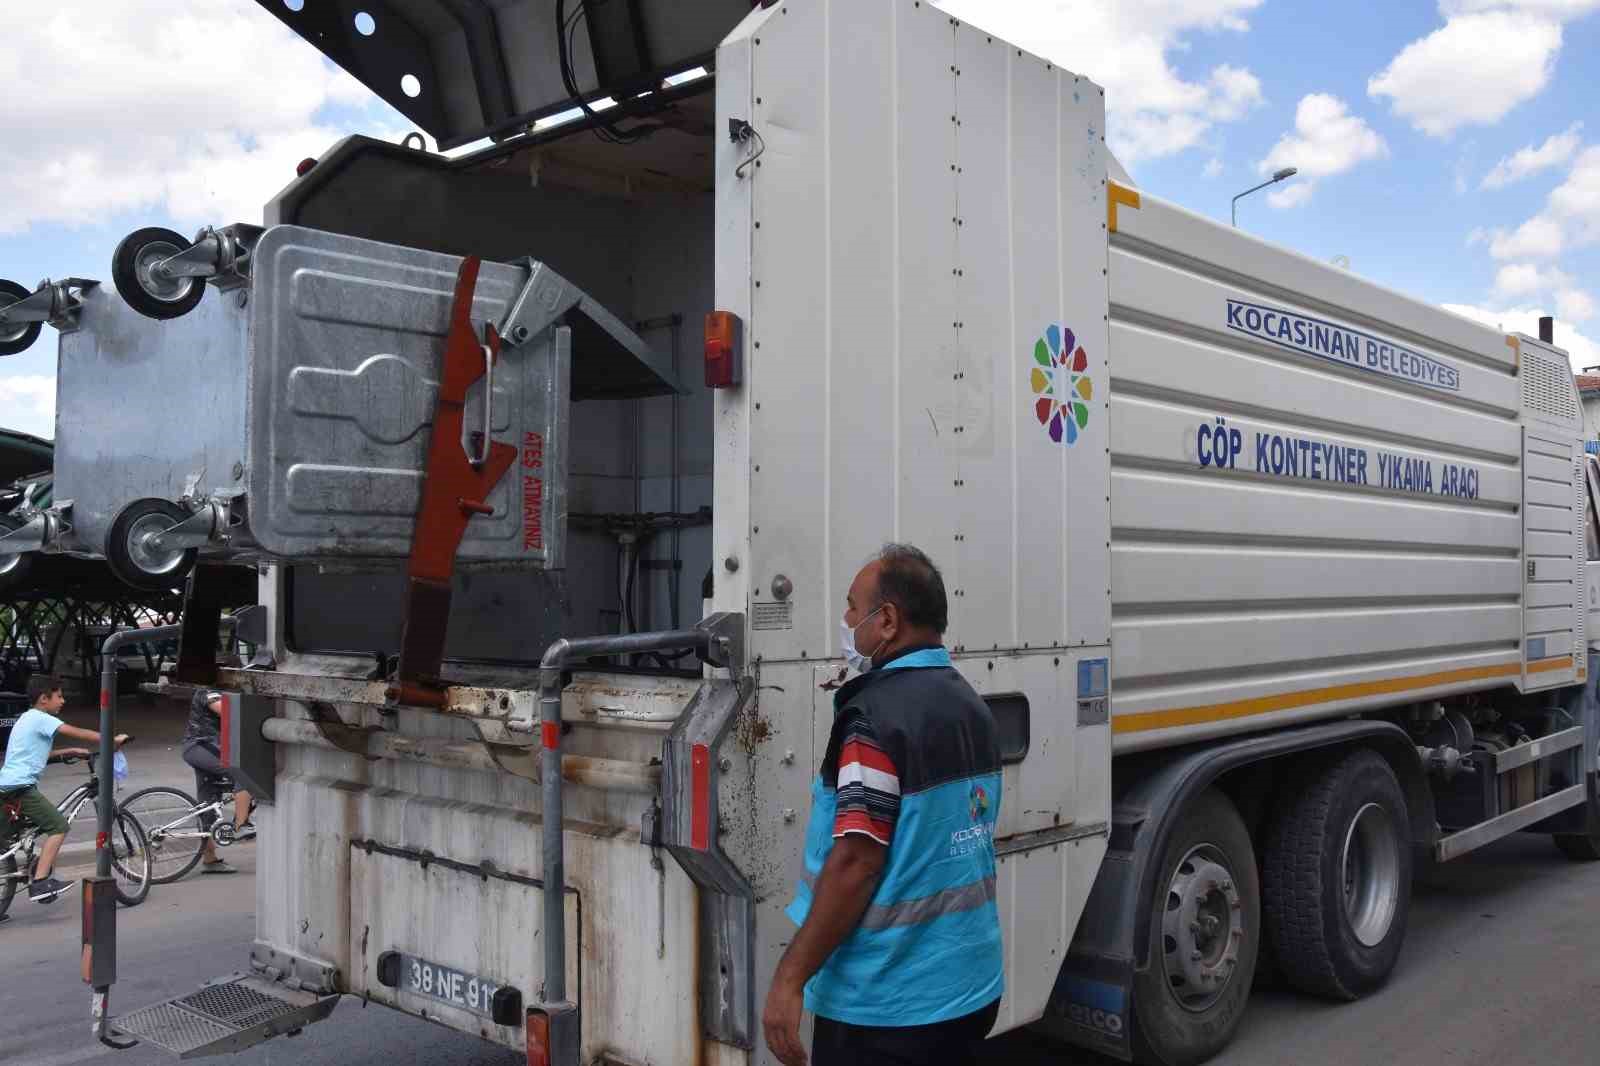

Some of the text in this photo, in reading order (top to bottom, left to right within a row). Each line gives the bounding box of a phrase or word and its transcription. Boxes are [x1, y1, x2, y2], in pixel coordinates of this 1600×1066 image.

[1227, 303, 1460, 388] KOCASİNAN BELEDİYESİ
[1198, 416, 1479, 500] ÇÖP KONTEYNER YIKAMA ARACI
[411, 961, 433, 993] 38
[437, 970, 465, 1004] NE
